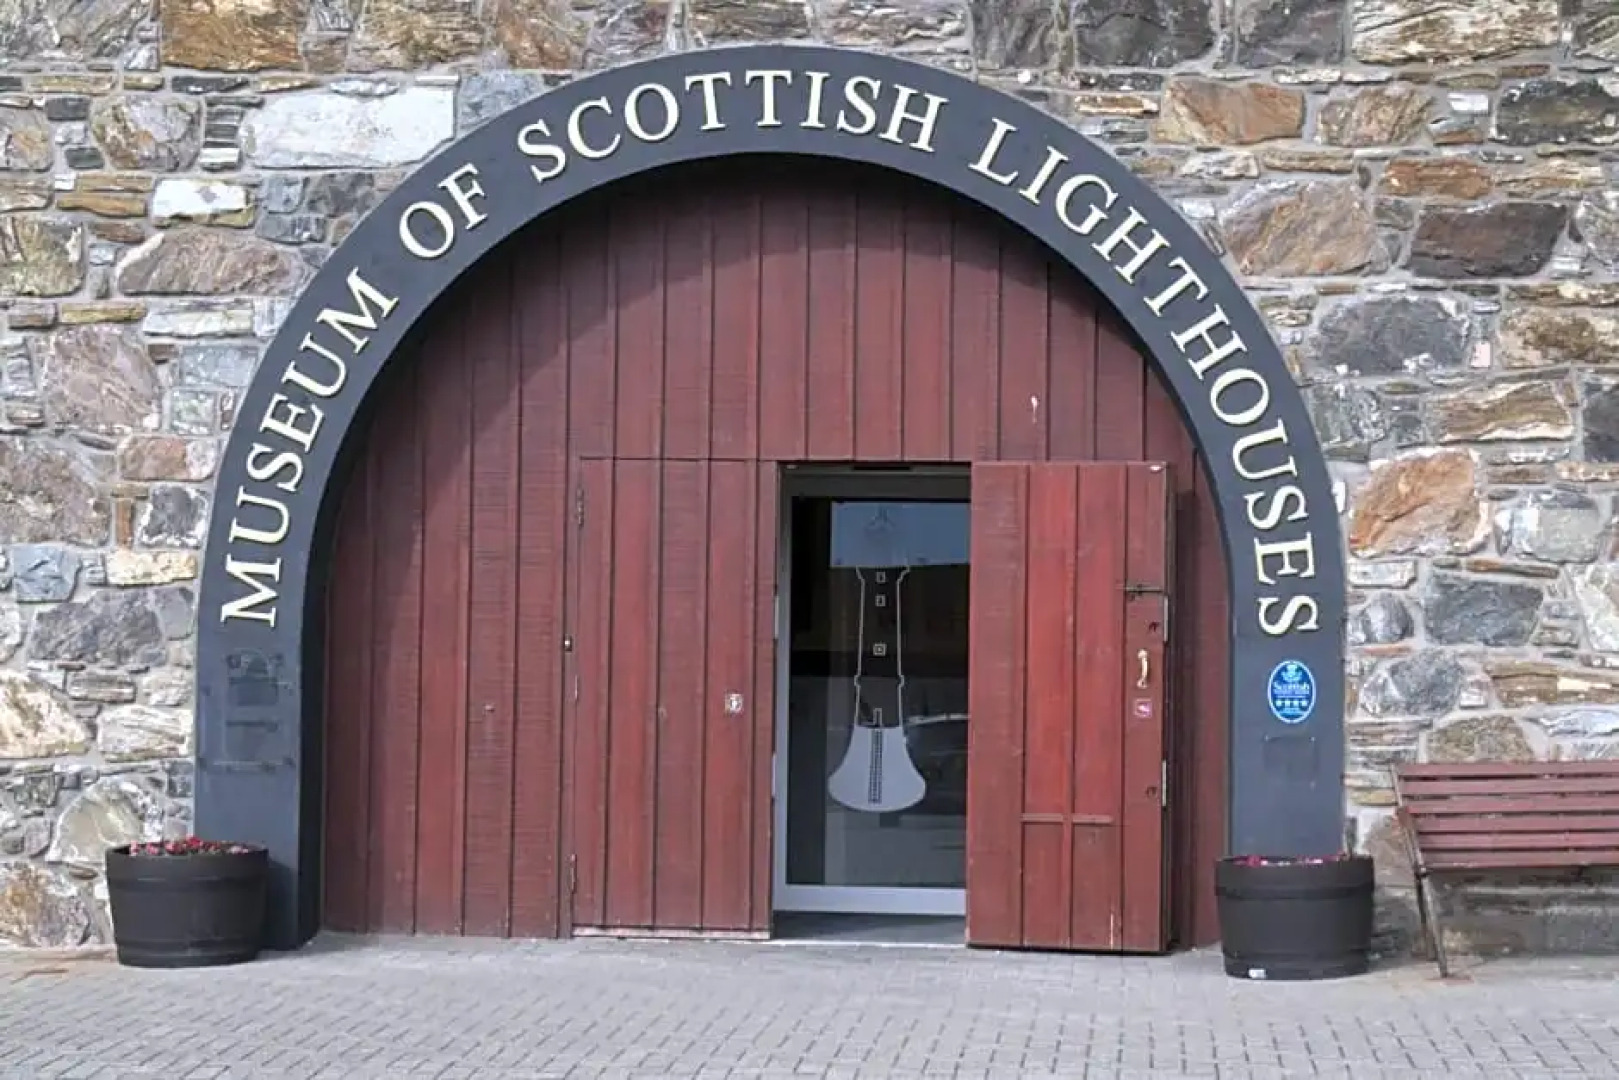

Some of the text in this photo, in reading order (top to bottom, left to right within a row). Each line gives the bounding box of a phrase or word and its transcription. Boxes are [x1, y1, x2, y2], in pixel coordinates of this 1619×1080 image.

[220, 70, 1319, 636] MUSEUM OF SCOTTISH LIGHTHOUSES
